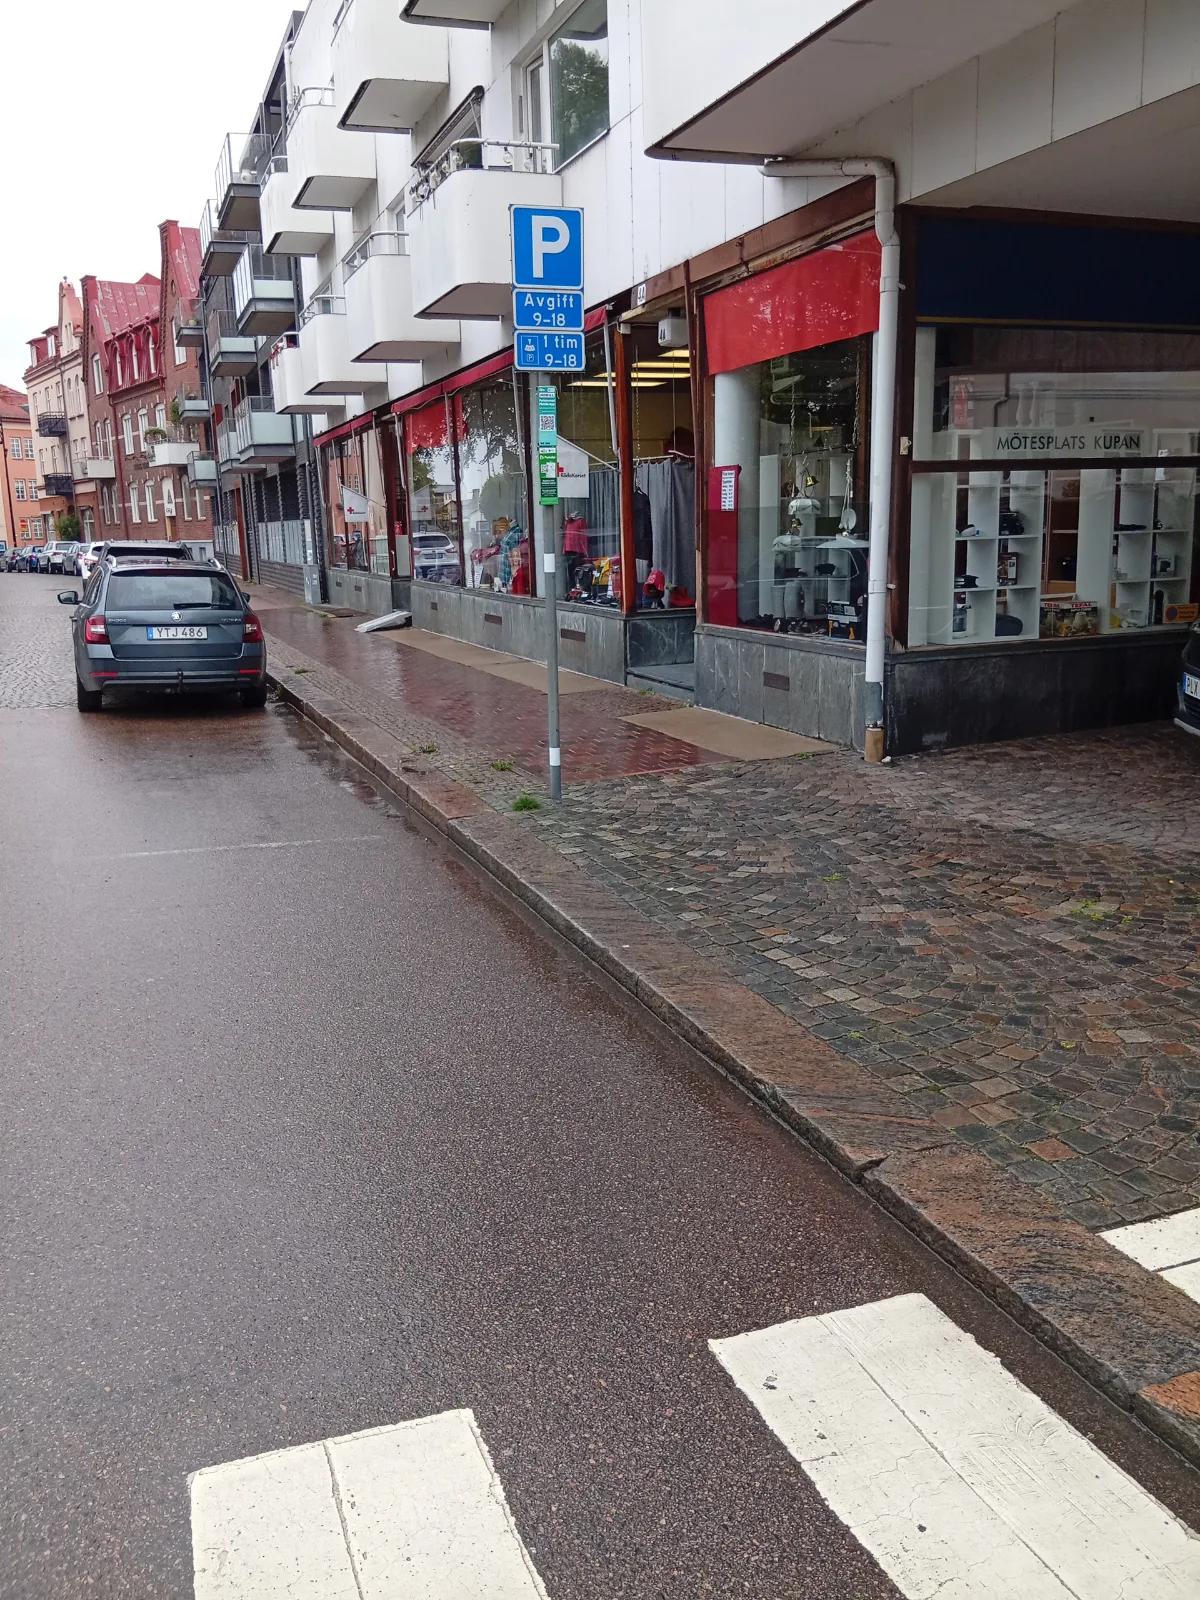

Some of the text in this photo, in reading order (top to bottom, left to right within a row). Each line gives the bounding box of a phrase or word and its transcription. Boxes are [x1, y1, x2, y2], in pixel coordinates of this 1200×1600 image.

[531, 215, 570, 278] P
[524, 294, 574, 310] Avgift
[533, 313, 566, 326] 9-18
[543, 335, 578, 349] 1 tim
[545, 354, 577, 367] 9-18
[997, 433, 1140, 450] MÖTESPLATS KUPAN
[156, 627, 203, 638] YTJ 486
